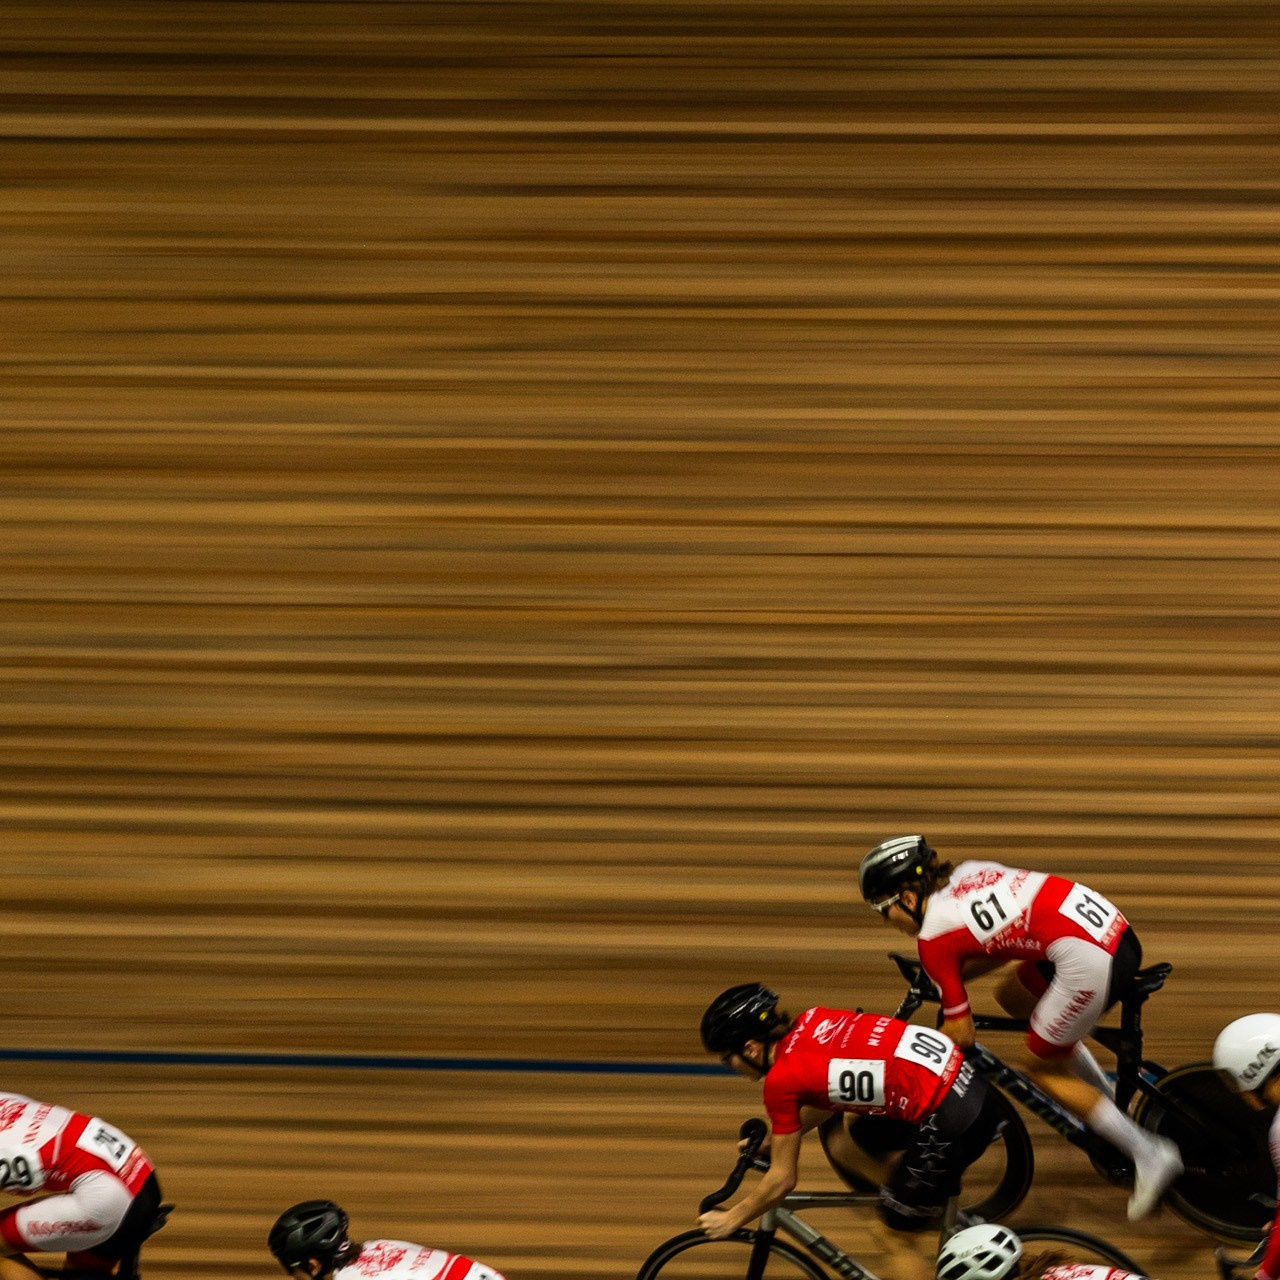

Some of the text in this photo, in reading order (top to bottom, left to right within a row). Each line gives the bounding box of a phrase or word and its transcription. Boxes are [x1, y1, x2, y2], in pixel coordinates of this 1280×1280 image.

[970, 892, 1007, 931] 61
[1075, 893, 1110, 928] 61
[910, 1032, 947, 1064] 90
[839, 1070, 875, 1102] 90
[0, 1156, 33, 1188] 29
